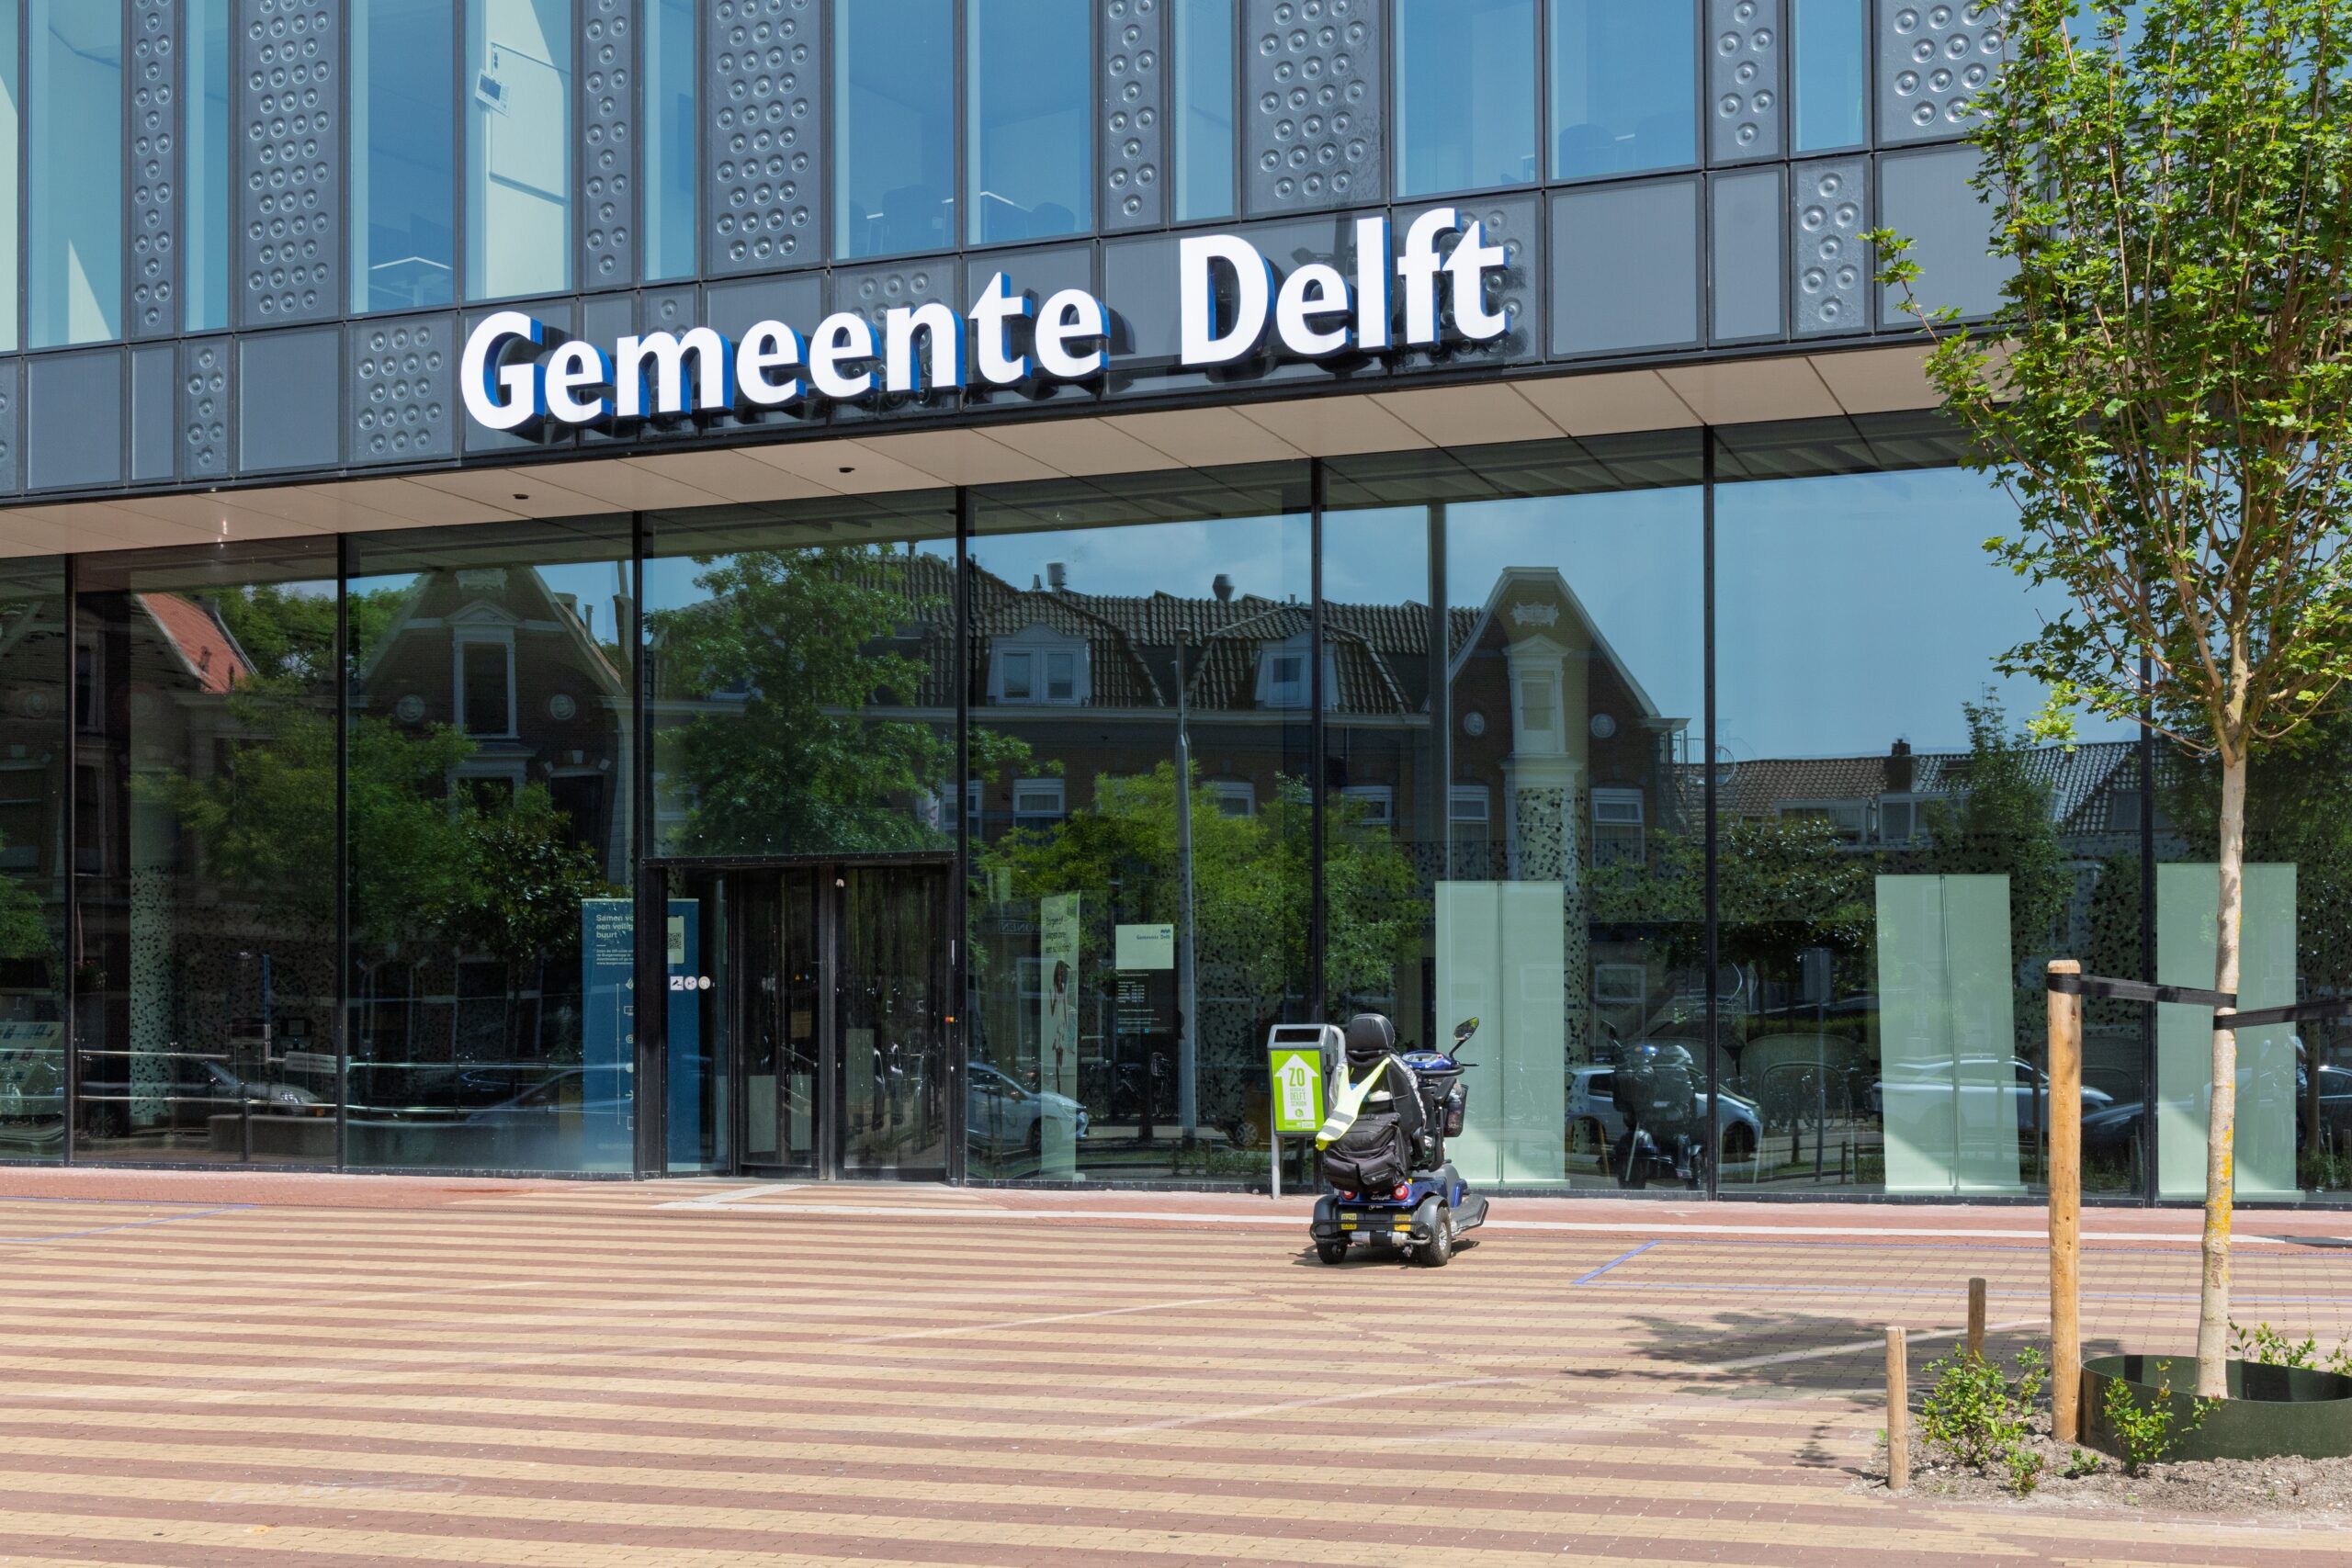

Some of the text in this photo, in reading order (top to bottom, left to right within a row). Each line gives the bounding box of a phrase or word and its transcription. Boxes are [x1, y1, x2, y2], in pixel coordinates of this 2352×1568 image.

[459, 208, 1509, 430] Gemeente Delft
[1288, 1067, 1306, 1087] ZO
[1290, 1092, 1306, 1100] DELFT
